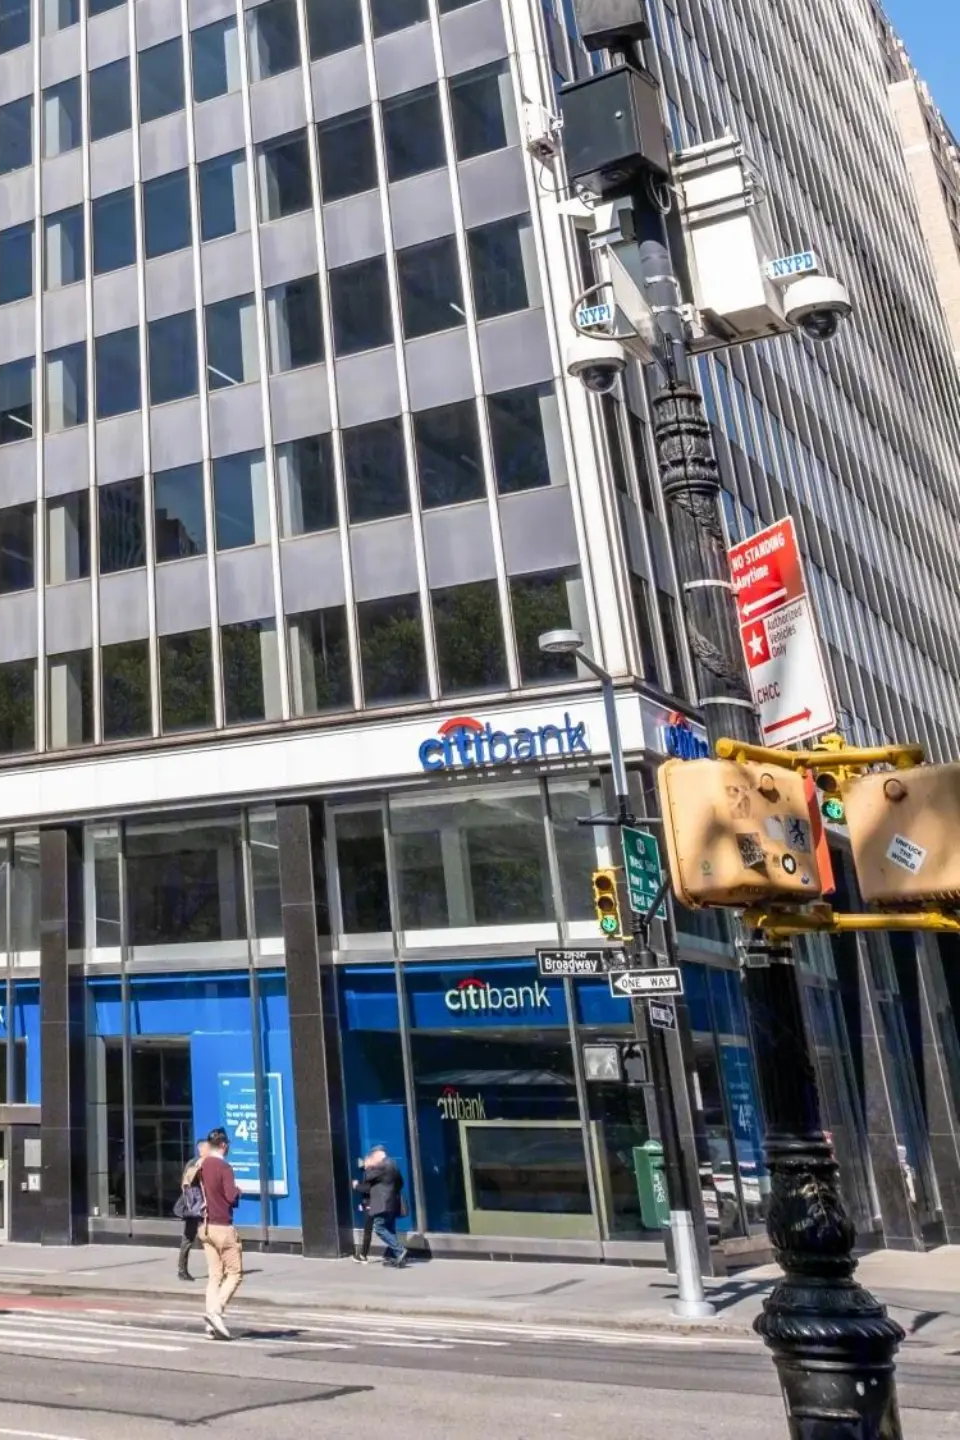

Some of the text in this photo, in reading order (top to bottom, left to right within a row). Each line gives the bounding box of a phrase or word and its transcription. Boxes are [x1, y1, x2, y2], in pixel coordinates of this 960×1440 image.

[772, 252, 814, 276] NYPD
[731, 531, 786, 573] NO STANDING
[735, 563, 770, 590] Anytime
[767, 605, 803, 630] Authorized
[770, 624, 797, 644] Vehicles
[771, 644, 787, 658] Only
[756, 681, 781, 705] CHCC
[419, 711, 590, 771] citibank
[544, 957, 598, 972] Broadway
[445, 978, 551, 1010] citibank
[621, 976, 671, 989] ONE WAY
[437, 1088, 486, 1120] citibank
